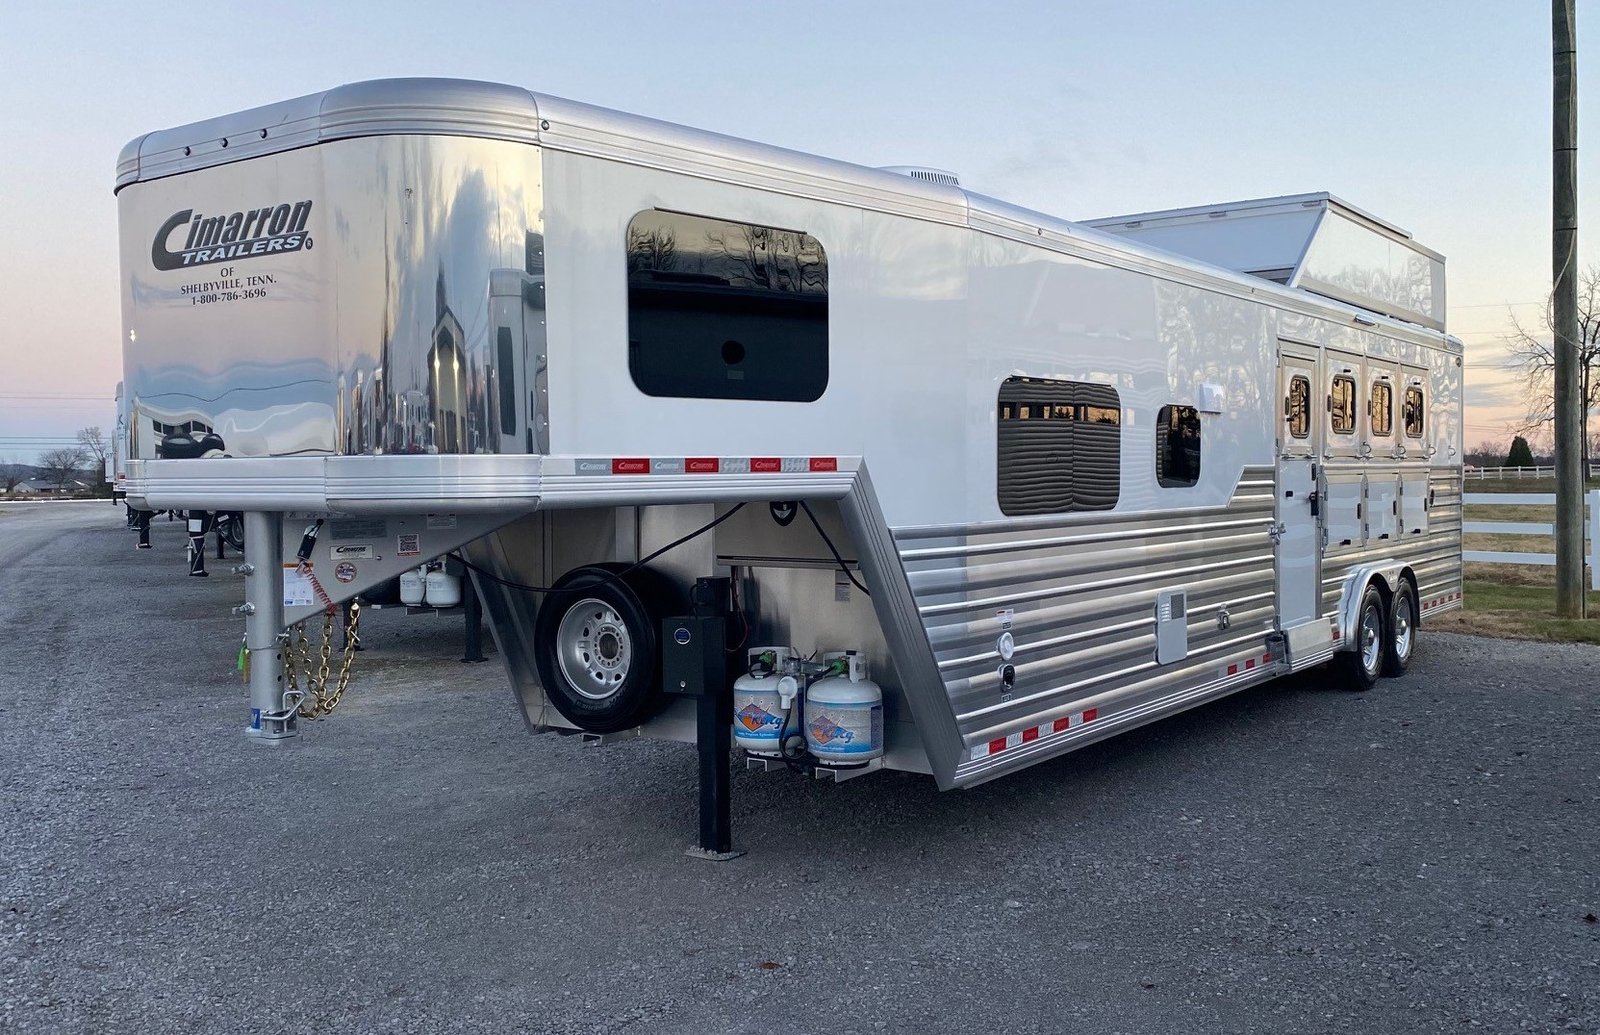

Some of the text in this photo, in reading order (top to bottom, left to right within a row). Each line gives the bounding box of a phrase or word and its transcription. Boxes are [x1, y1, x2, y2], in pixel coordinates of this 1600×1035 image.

[152, 200, 313, 270] Cimarron
[181, 234, 302, 265] TRAILERS
[220, 267, 235, 278] OF
[181, 274, 277, 295] SHELBYVILLE, TENN.
[191, 288, 267, 306] 1-800-786-3696
